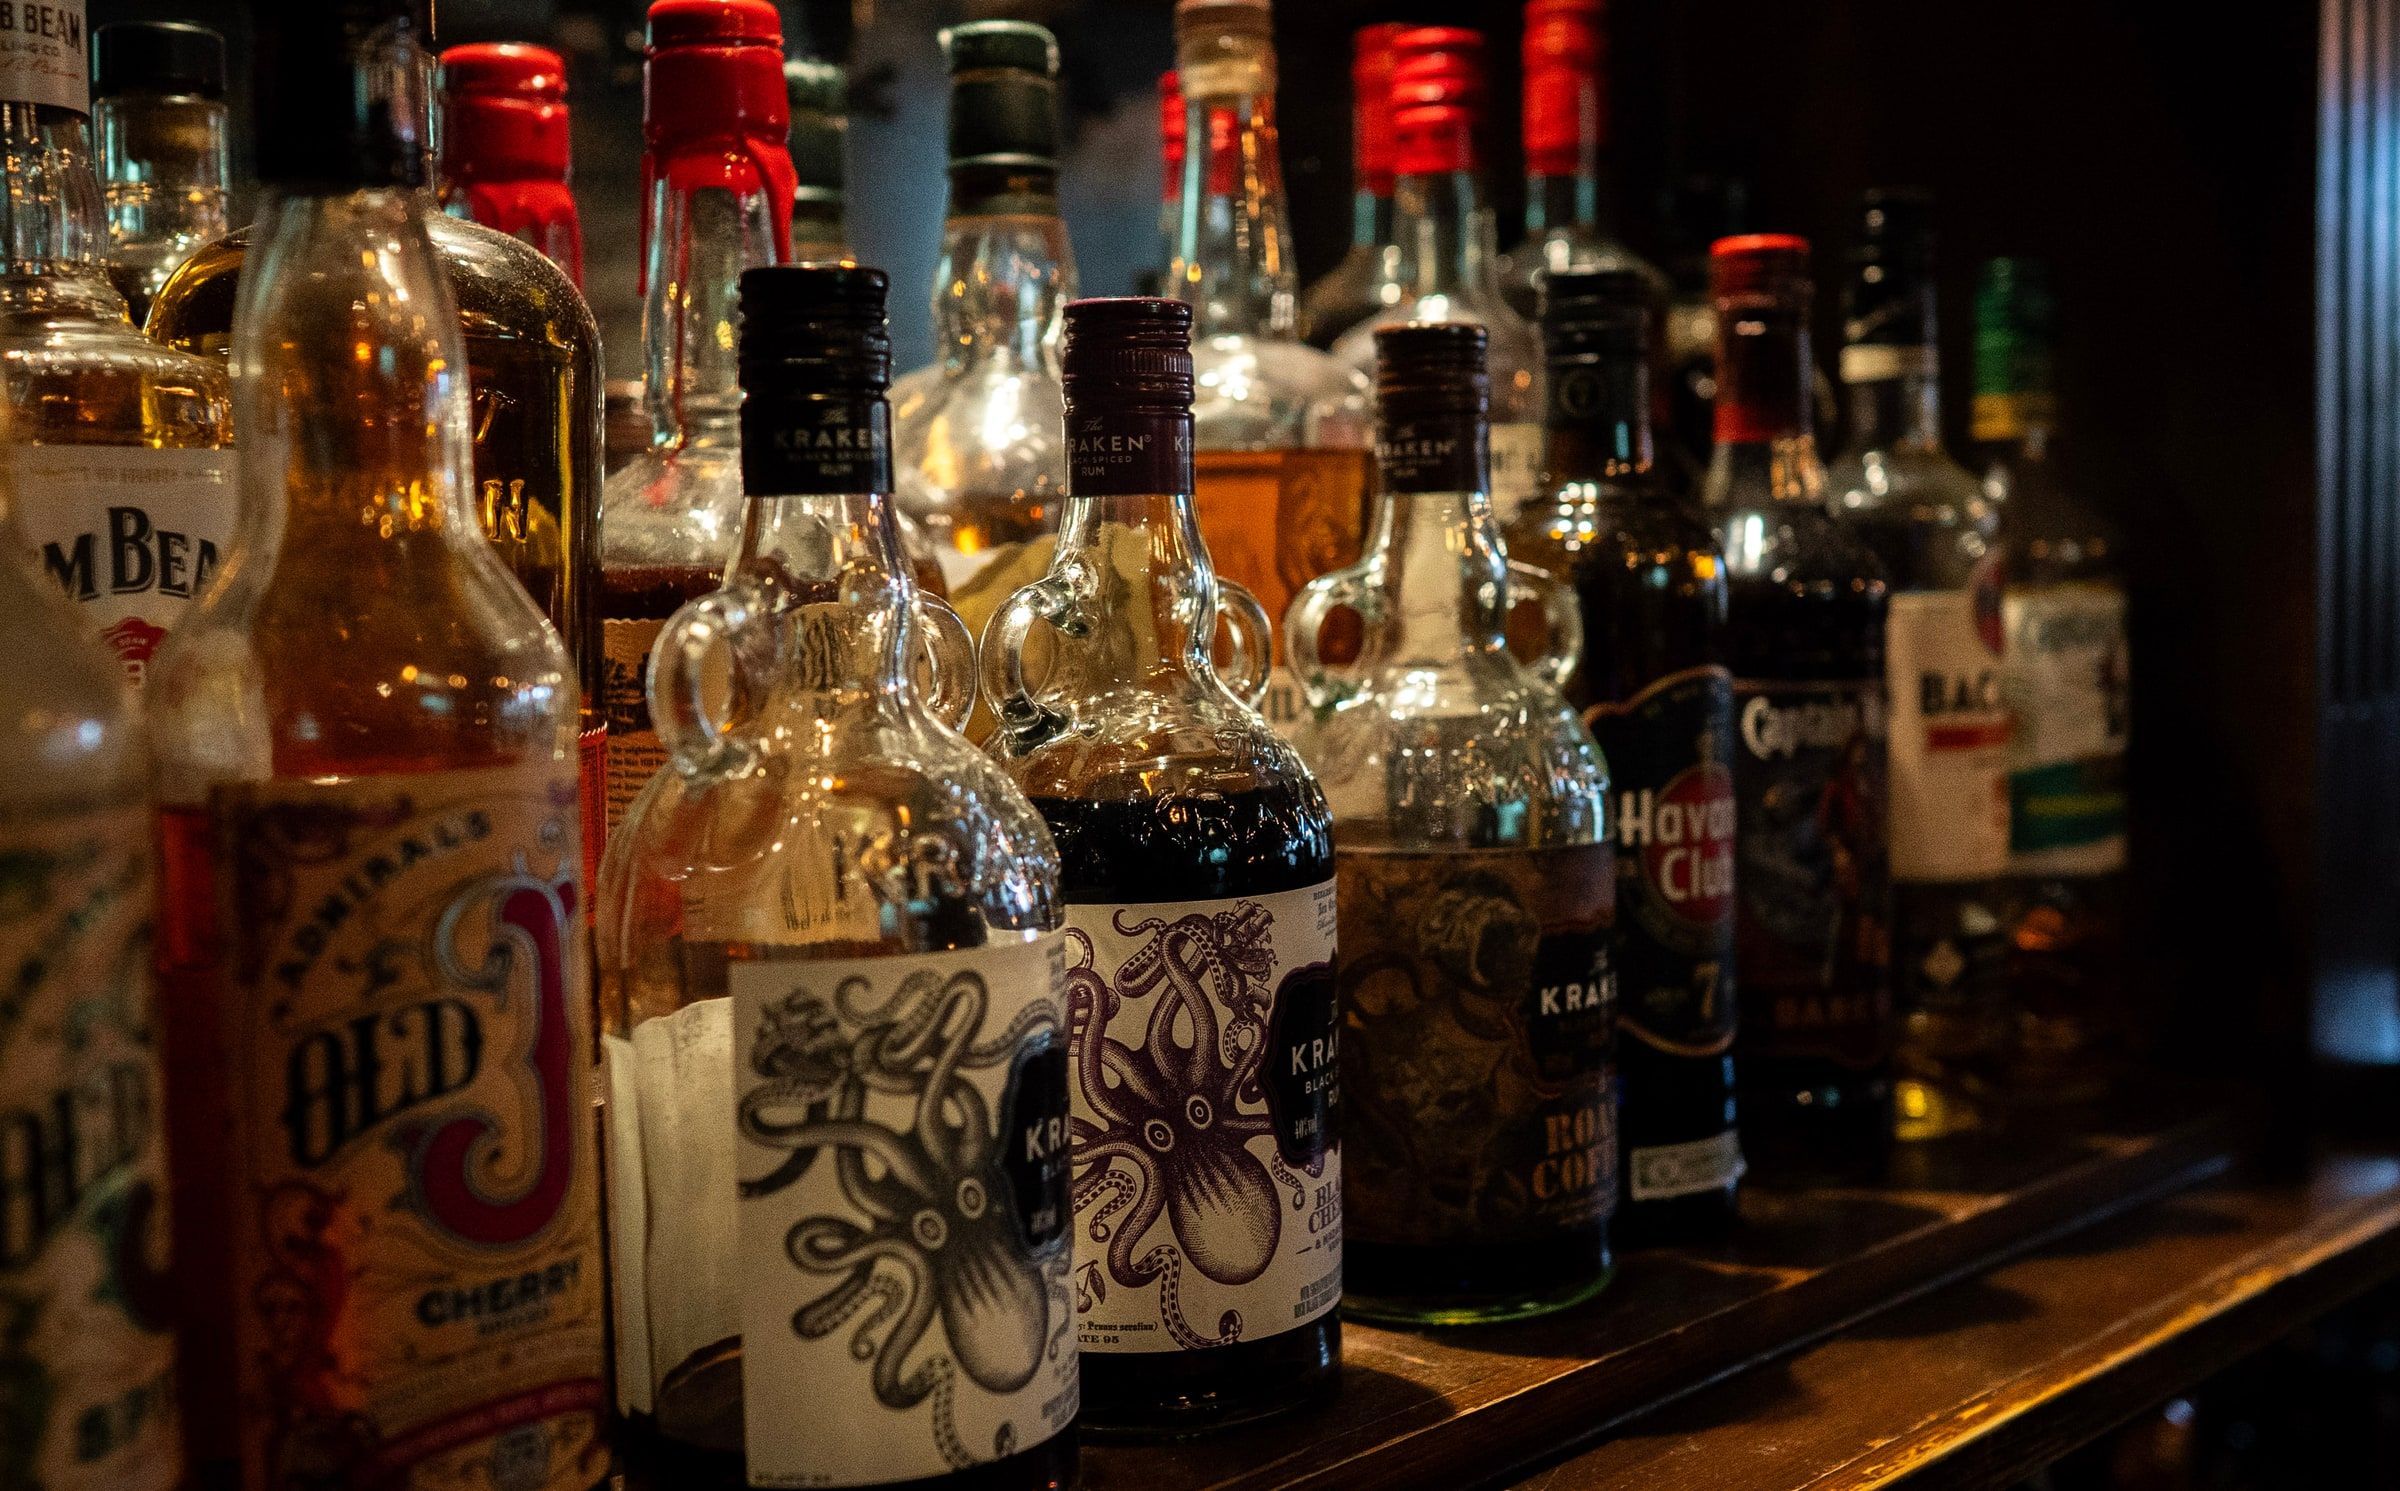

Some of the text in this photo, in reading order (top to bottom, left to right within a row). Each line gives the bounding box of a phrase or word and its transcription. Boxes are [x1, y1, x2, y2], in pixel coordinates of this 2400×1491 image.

[25, 4, 80, 50] BEAM
[1081, 466, 1105, 477] RUM
[1092, 455, 1133, 464] SPICED
[416, 1254, 582, 1328] CHERRY
